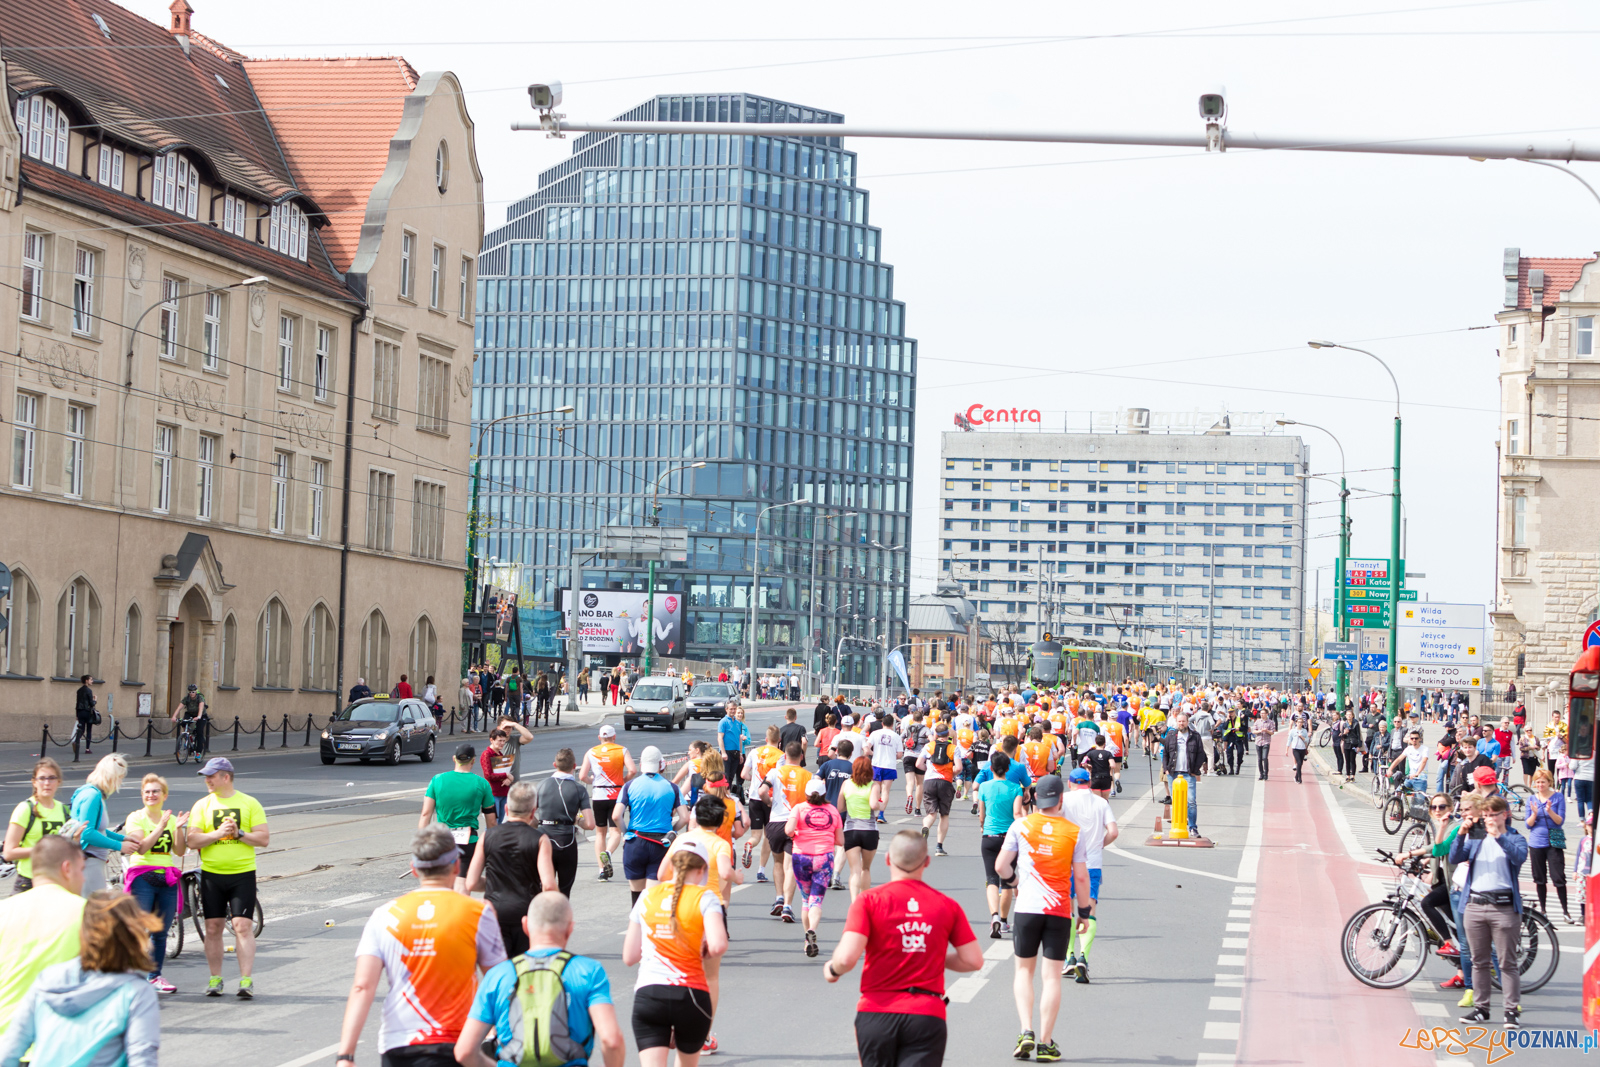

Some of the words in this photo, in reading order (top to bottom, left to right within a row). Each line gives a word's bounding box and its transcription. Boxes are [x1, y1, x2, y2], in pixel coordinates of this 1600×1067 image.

[967, 404, 1041, 425] Centra
[1096, 405, 1277, 432] akumulatory
[1353, 561, 1380, 569] Tranzyt
[1369, 590, 1389, 600] Nowy
[596, 610, 614, 618] BAR
[1420, 607, 1442, 615] Wilda
[1420, 616, 1447, 626] Rataje
[1045, 633, 1051, 641] 2
[1420, 632, 1446, 640] Jeżyce
[1420, 641, 1461, 651] Winogrady
[1420, 650, 1455, 659] Piątkowo
[1417, 667, 1437, 675] Stare
[1441, 667, 1460, 675] ZOO
[1416, 676, 1446, 686] Parking
[1449, 676, 1472, 686] bufor.
[896, 921, 933, 935] TEAM
